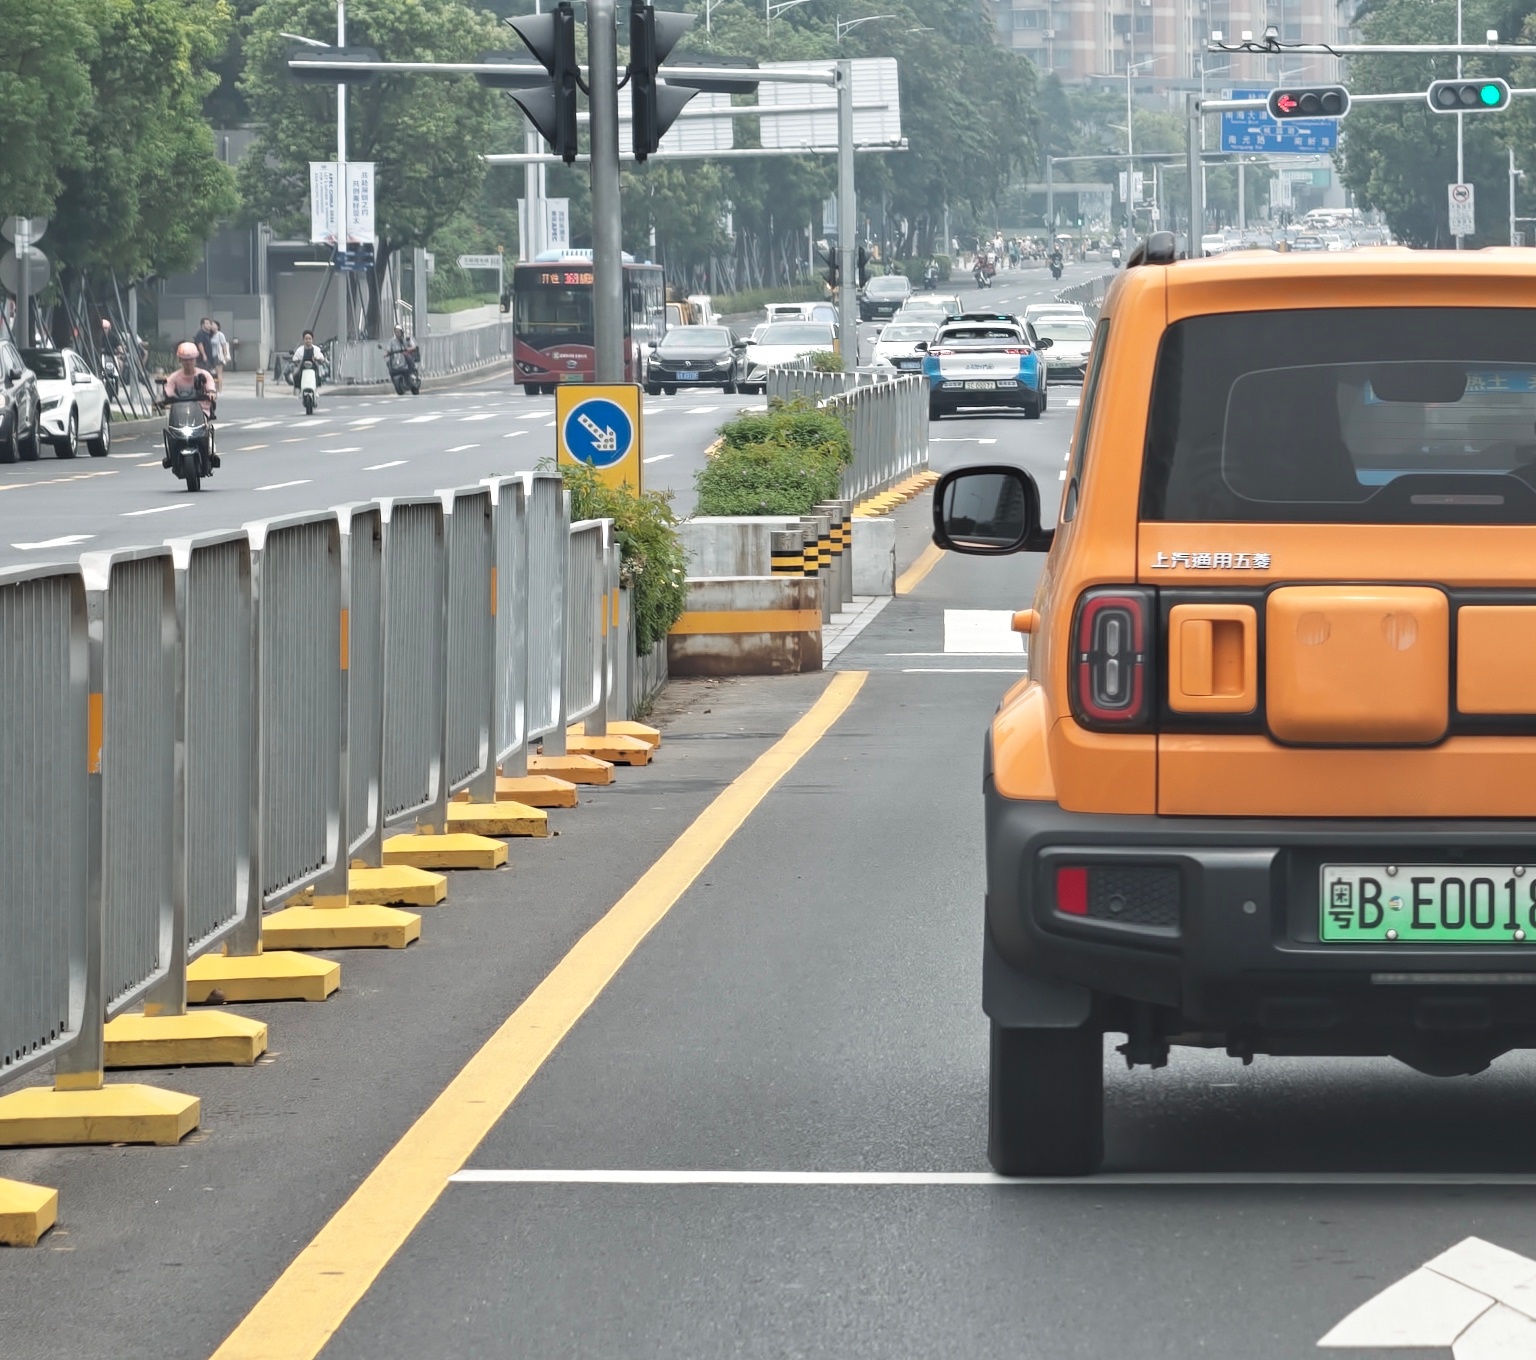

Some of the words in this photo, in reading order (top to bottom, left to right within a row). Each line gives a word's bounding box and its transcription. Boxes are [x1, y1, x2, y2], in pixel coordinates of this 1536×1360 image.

[1151, 552, 1271, 569] 上汽通用五菱
